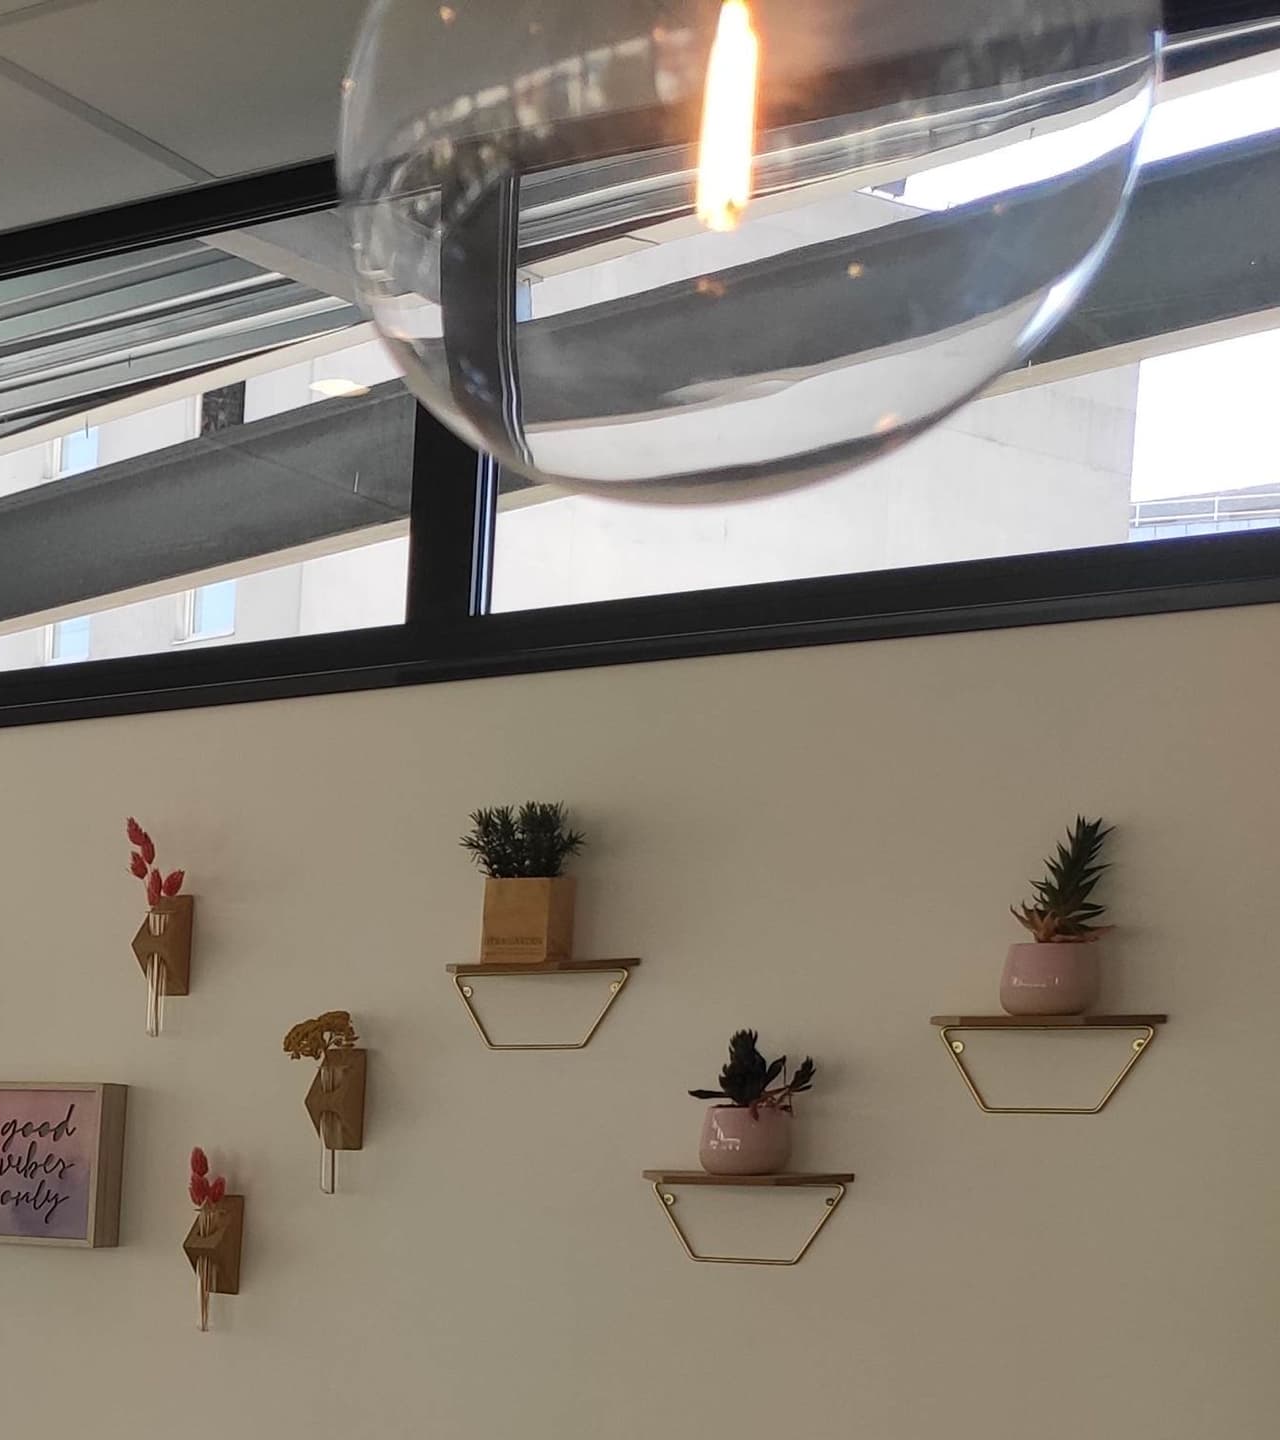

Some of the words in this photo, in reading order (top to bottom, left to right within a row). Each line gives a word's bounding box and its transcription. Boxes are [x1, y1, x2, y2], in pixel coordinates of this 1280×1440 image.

[0, 1104, 76, 1152] good
[0, 1141, 75, 1179] vibes
[0, 1180, 70, 1222] only
